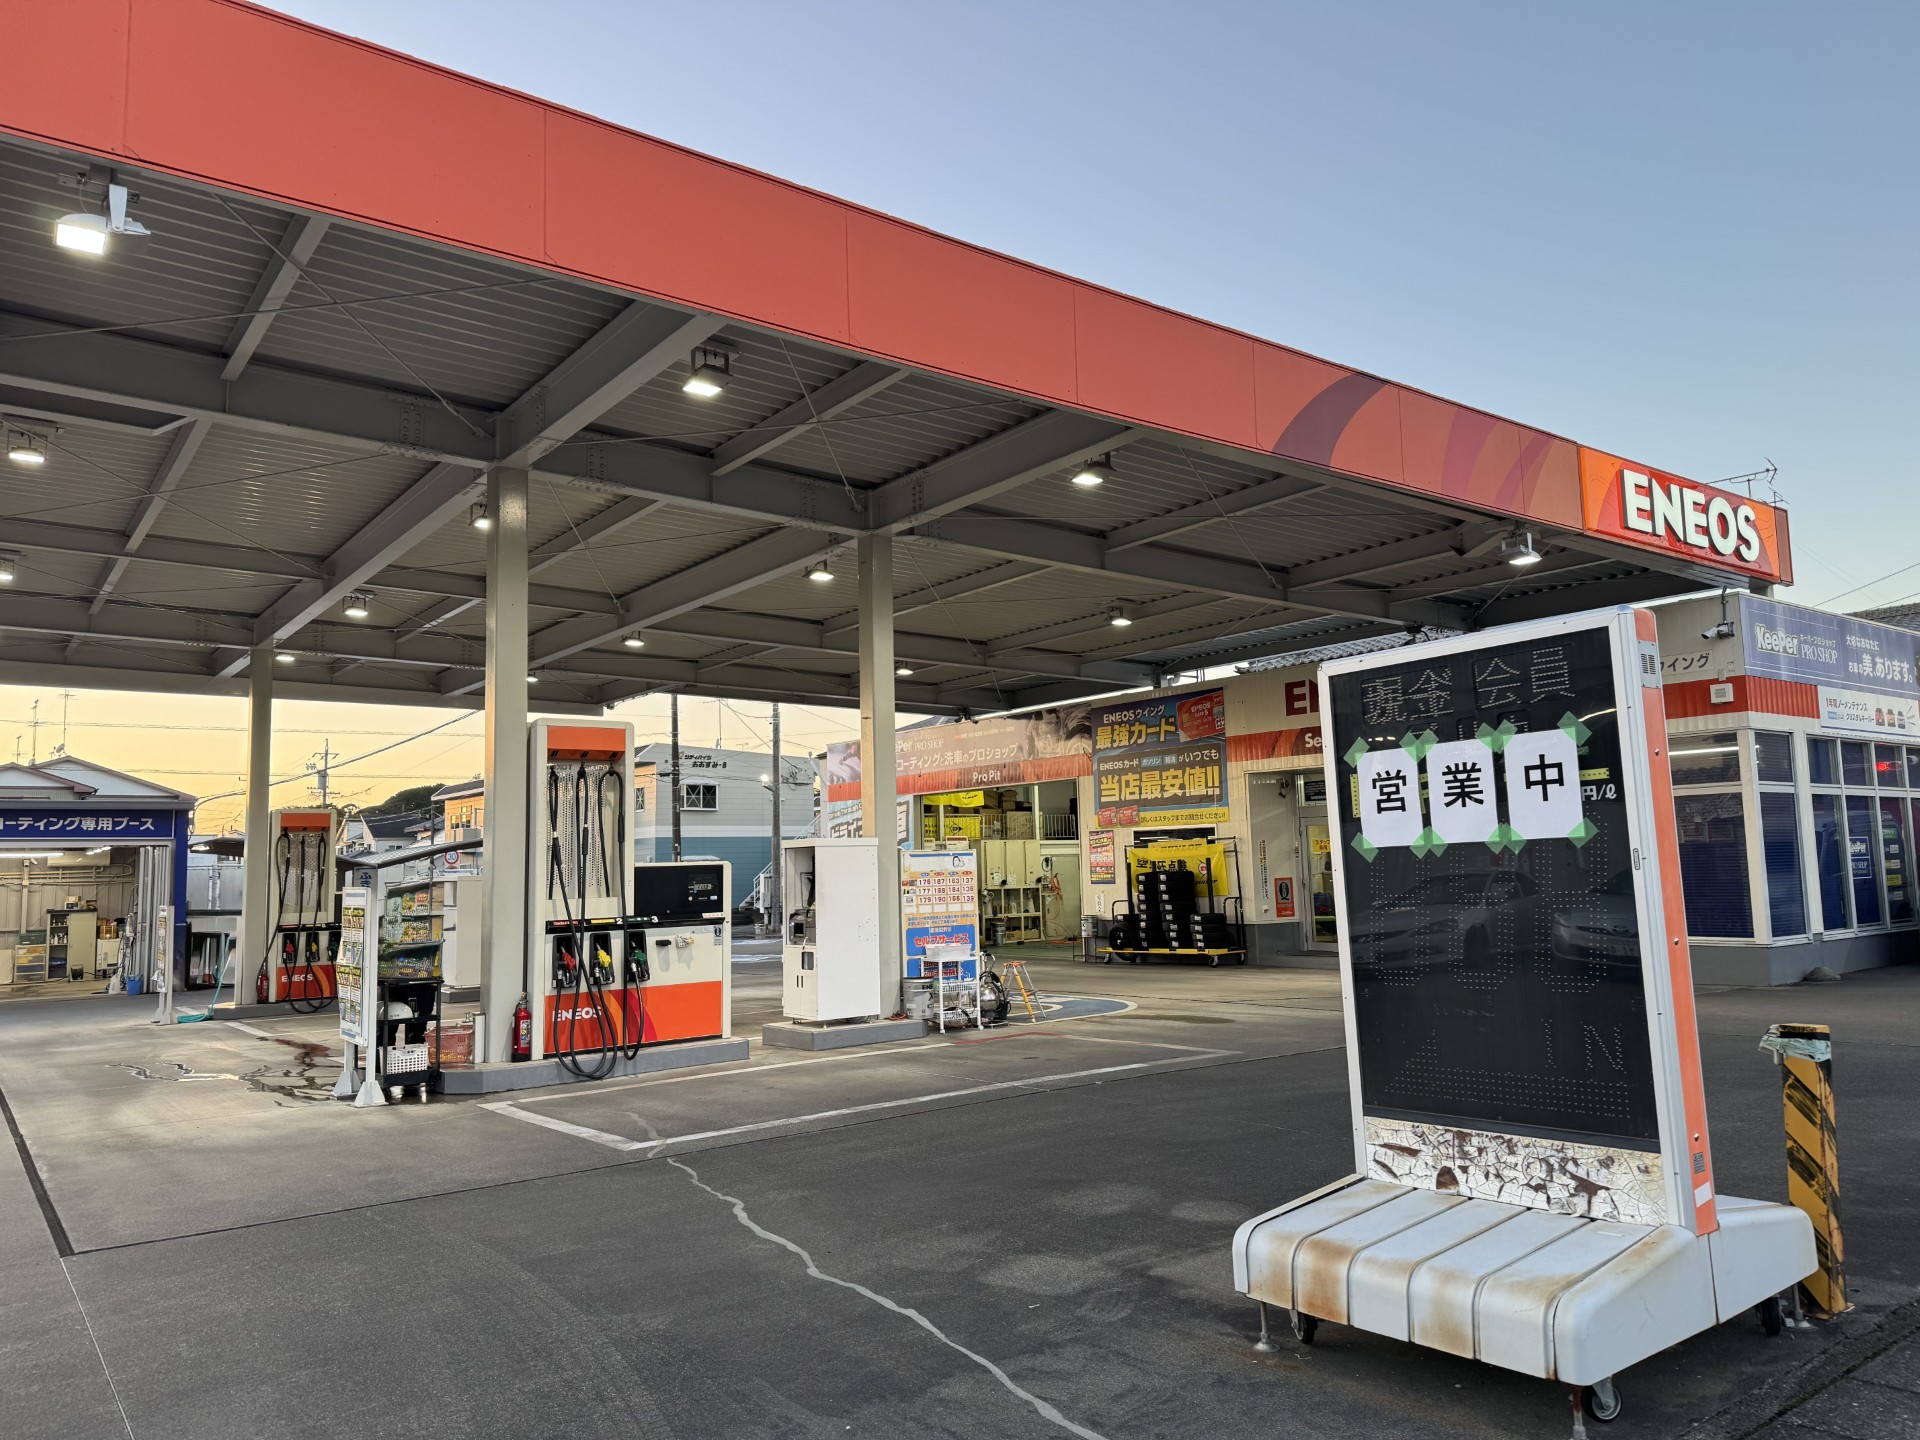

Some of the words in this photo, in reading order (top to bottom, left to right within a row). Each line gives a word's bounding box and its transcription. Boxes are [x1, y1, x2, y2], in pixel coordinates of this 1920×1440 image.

[1620, 468, 1760, 562] ENEOS
[1755, 623, 1798, 656] KeePer
[1801, 643, 1818, 661] PRO
[1818, 647, 1838, 664] SHOP
[1095, 717, 1176, 750] 最強カード
[896, 742, 1019, 771] コーティングと洗車のプロショップ
[1371, 753, 1565, 815] 営業中
[447, 852, 457, 861] 30
[651, 915, 659, 923] 3
